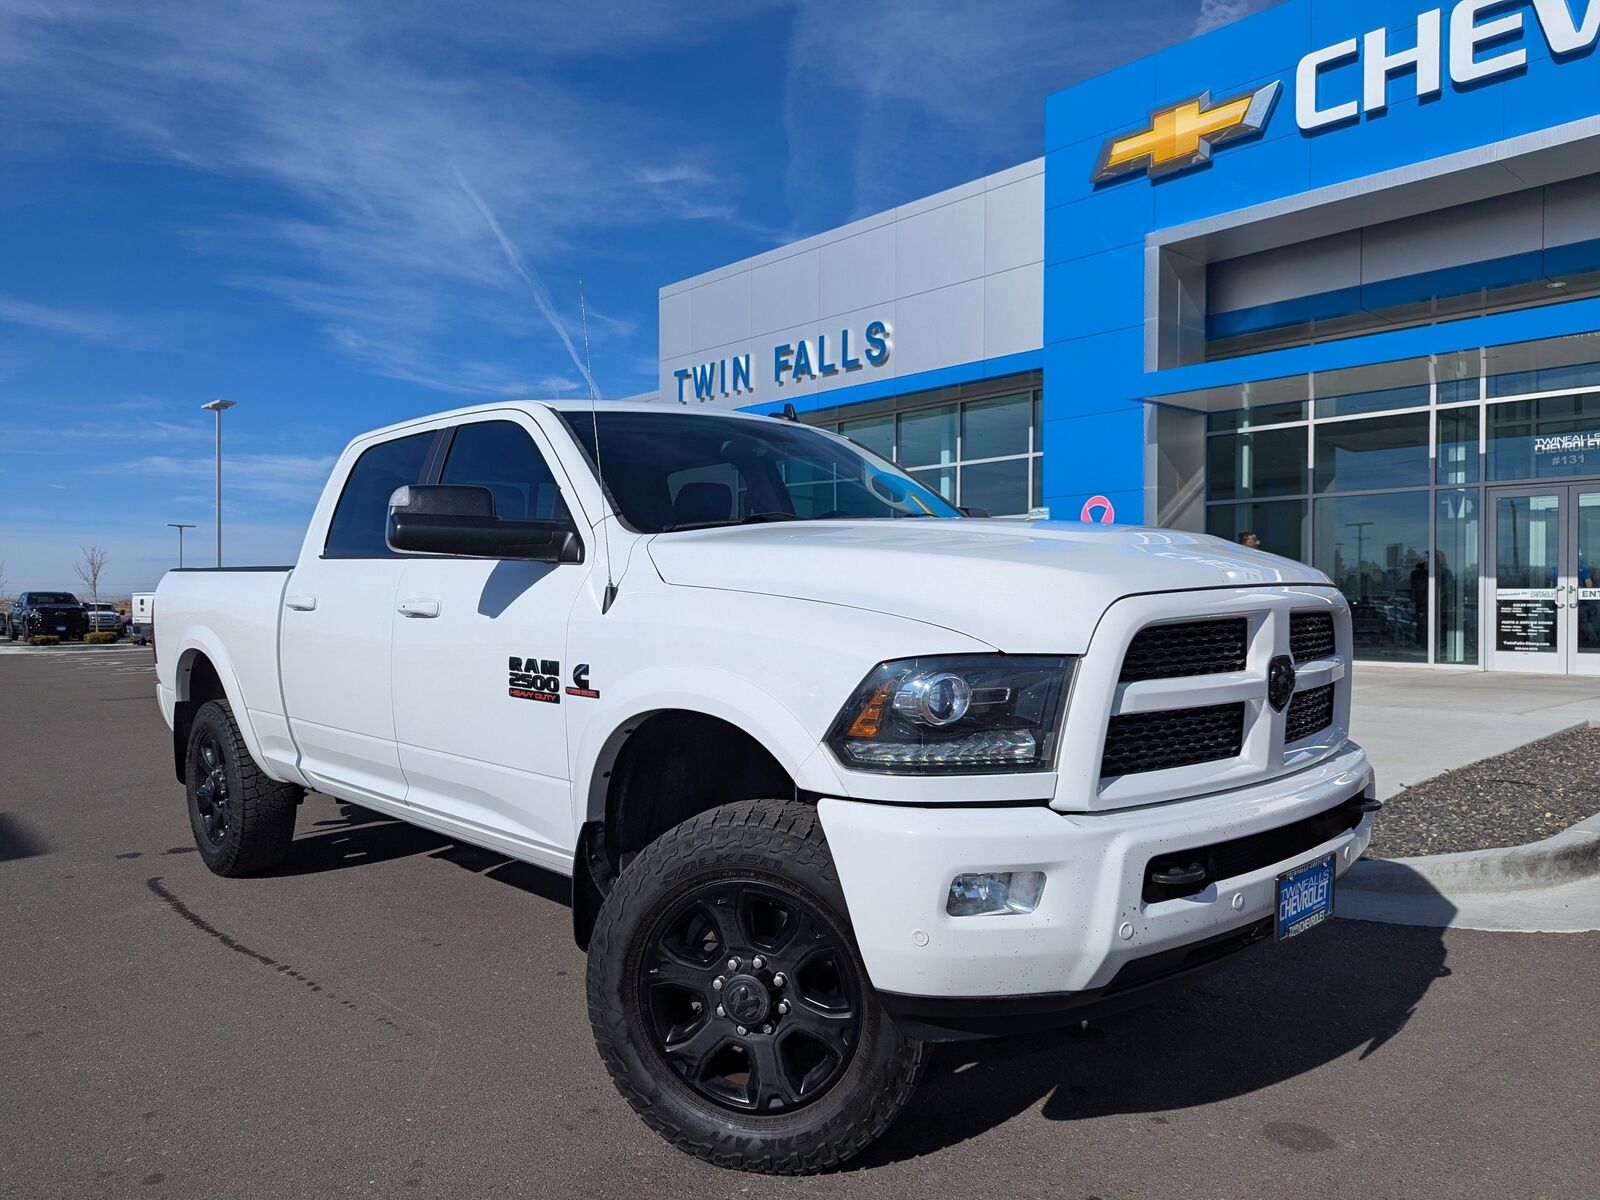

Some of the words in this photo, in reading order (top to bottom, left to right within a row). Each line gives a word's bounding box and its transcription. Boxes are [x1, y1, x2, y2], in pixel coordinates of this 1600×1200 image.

[1296, 0, 1600, 130] CHEV
[674, 353, 751, 403] TWIN
[774, 320, 888, 386] FALLS
[1552, 454, 1585, 466] #131
[508, 656, 560, 677] RAM
[508, 672, 560, 693] 2500
[510, 689, 534, 699] HEAVY
[534, 693, 557, 702] DUTY
[1279, 880, 1329, 921] CHEVROLET
